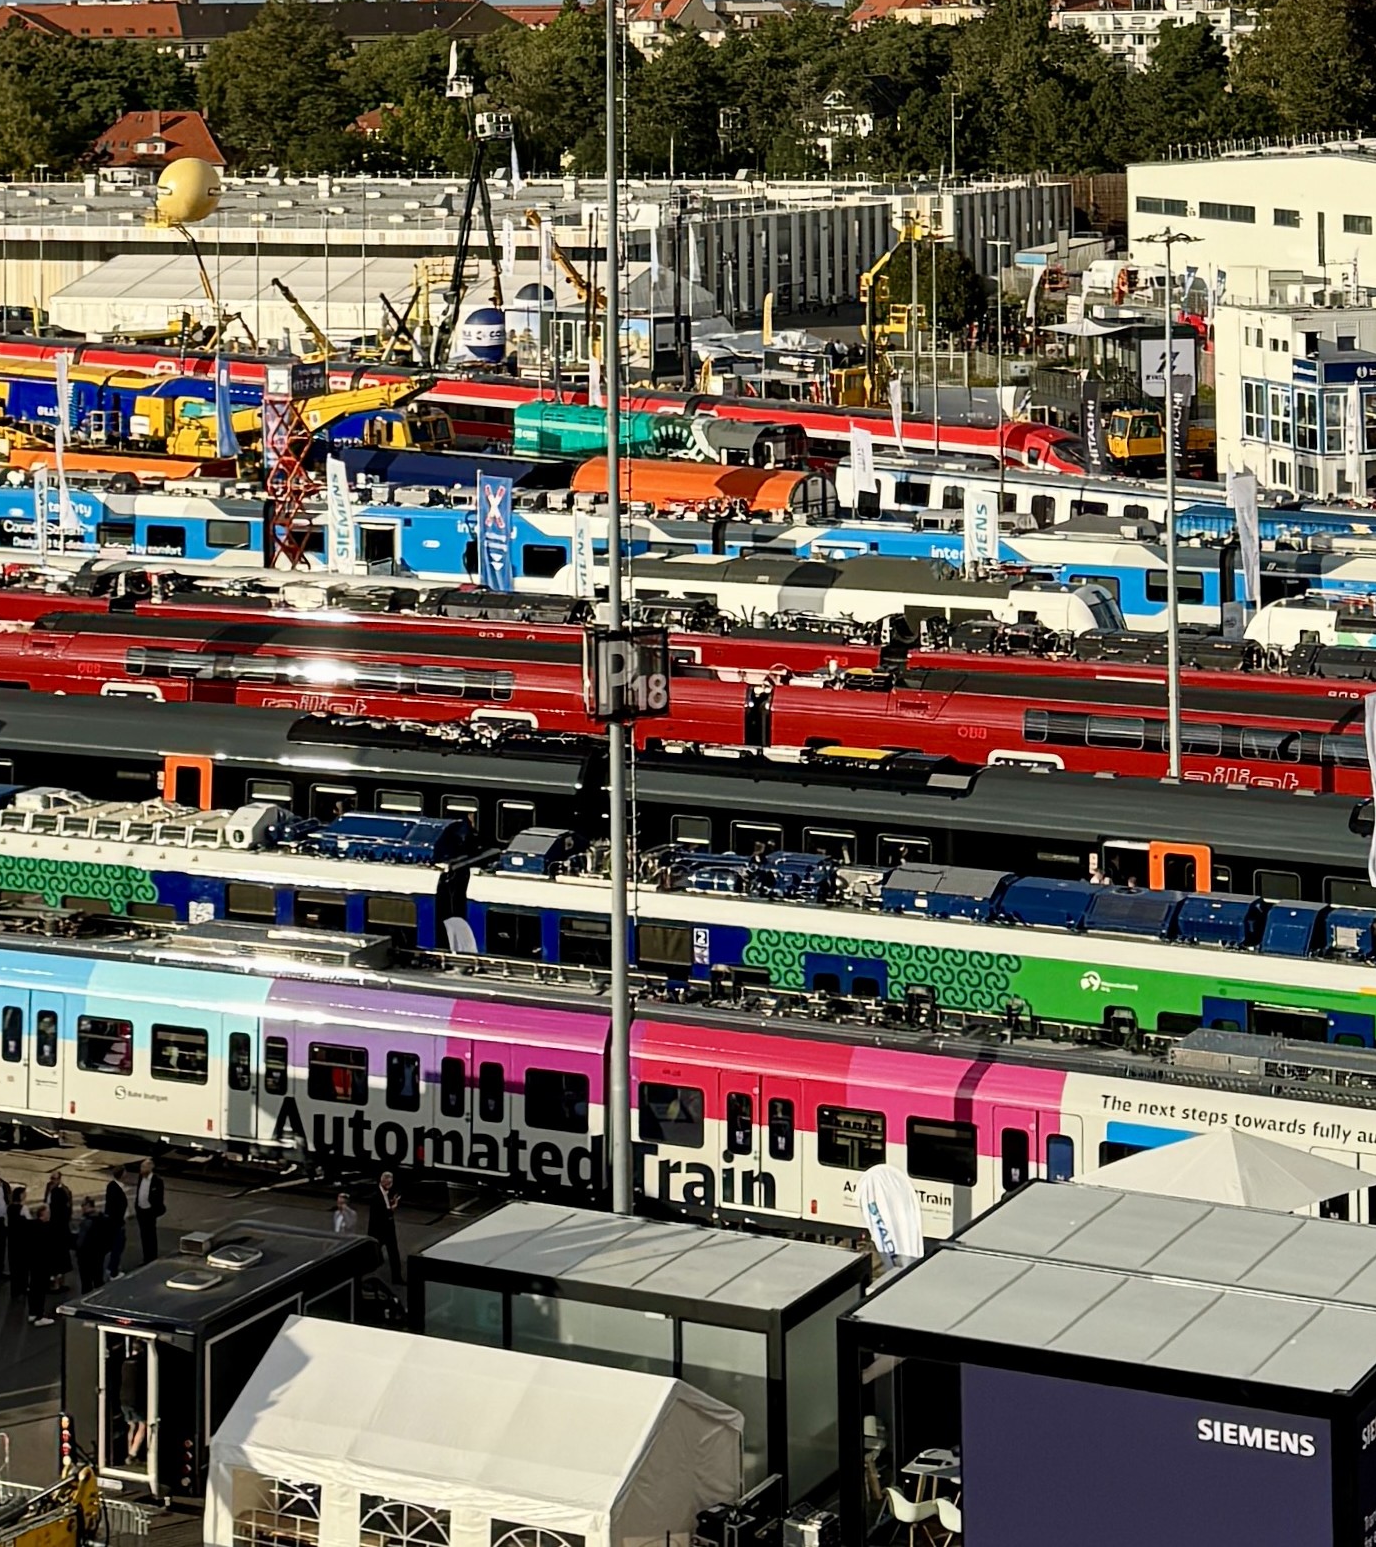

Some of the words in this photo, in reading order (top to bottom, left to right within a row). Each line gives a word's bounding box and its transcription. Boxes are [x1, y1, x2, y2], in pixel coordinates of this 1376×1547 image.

[1087, 399, 1101, 466] HITACHI
[330, 473, 350, 559] SIEMENS
[598, 640, 637, 715] P
[632, 673, 668, 711] 18
[696, 930, 706, 944] 2
[1101, 1094, 1132, 1112] The
[1138, 1102, 1176, 1119] next
[1182, 1105, 1229, 1127] steps
[1234, 1112, 1307, 1136] towards
[1312, 1120, 1353, 1143] fully
[275, 1096, 604, 1190] Automated
[632, 1140, 777, 1209] Train
[1197, 1418, 1316, 1458] SIEMENS
